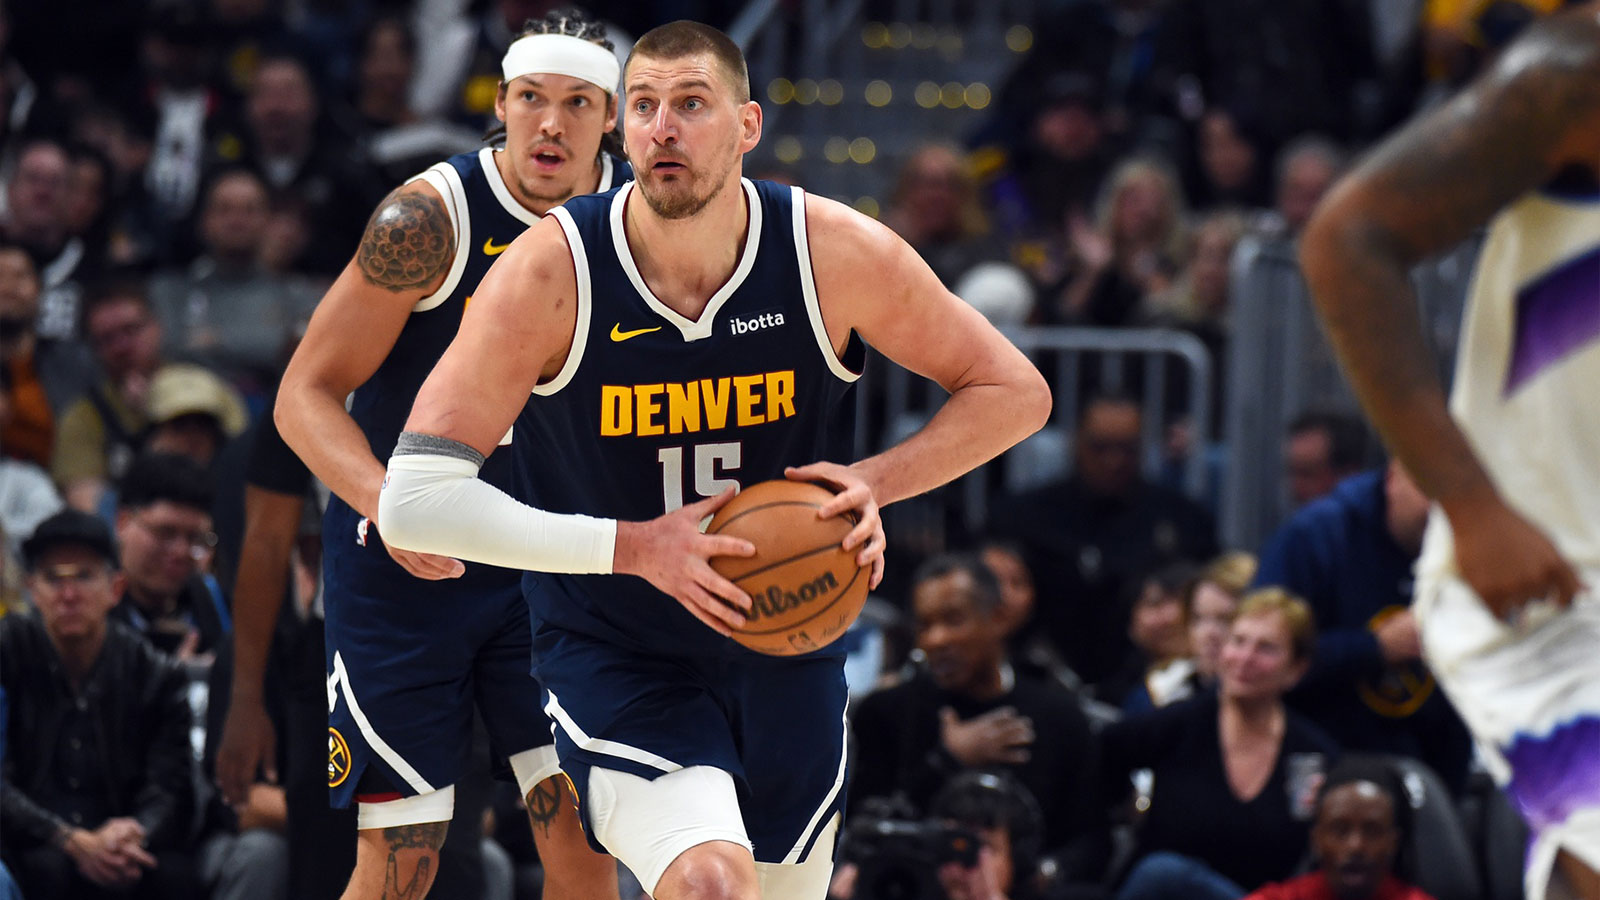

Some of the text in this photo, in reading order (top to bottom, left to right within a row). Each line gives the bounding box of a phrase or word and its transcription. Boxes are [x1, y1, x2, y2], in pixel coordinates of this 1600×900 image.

[730, 312, 785, 336] ibotta
[600, 369, 796, 437] DENVER
[657, 441, 742, 533] 15
